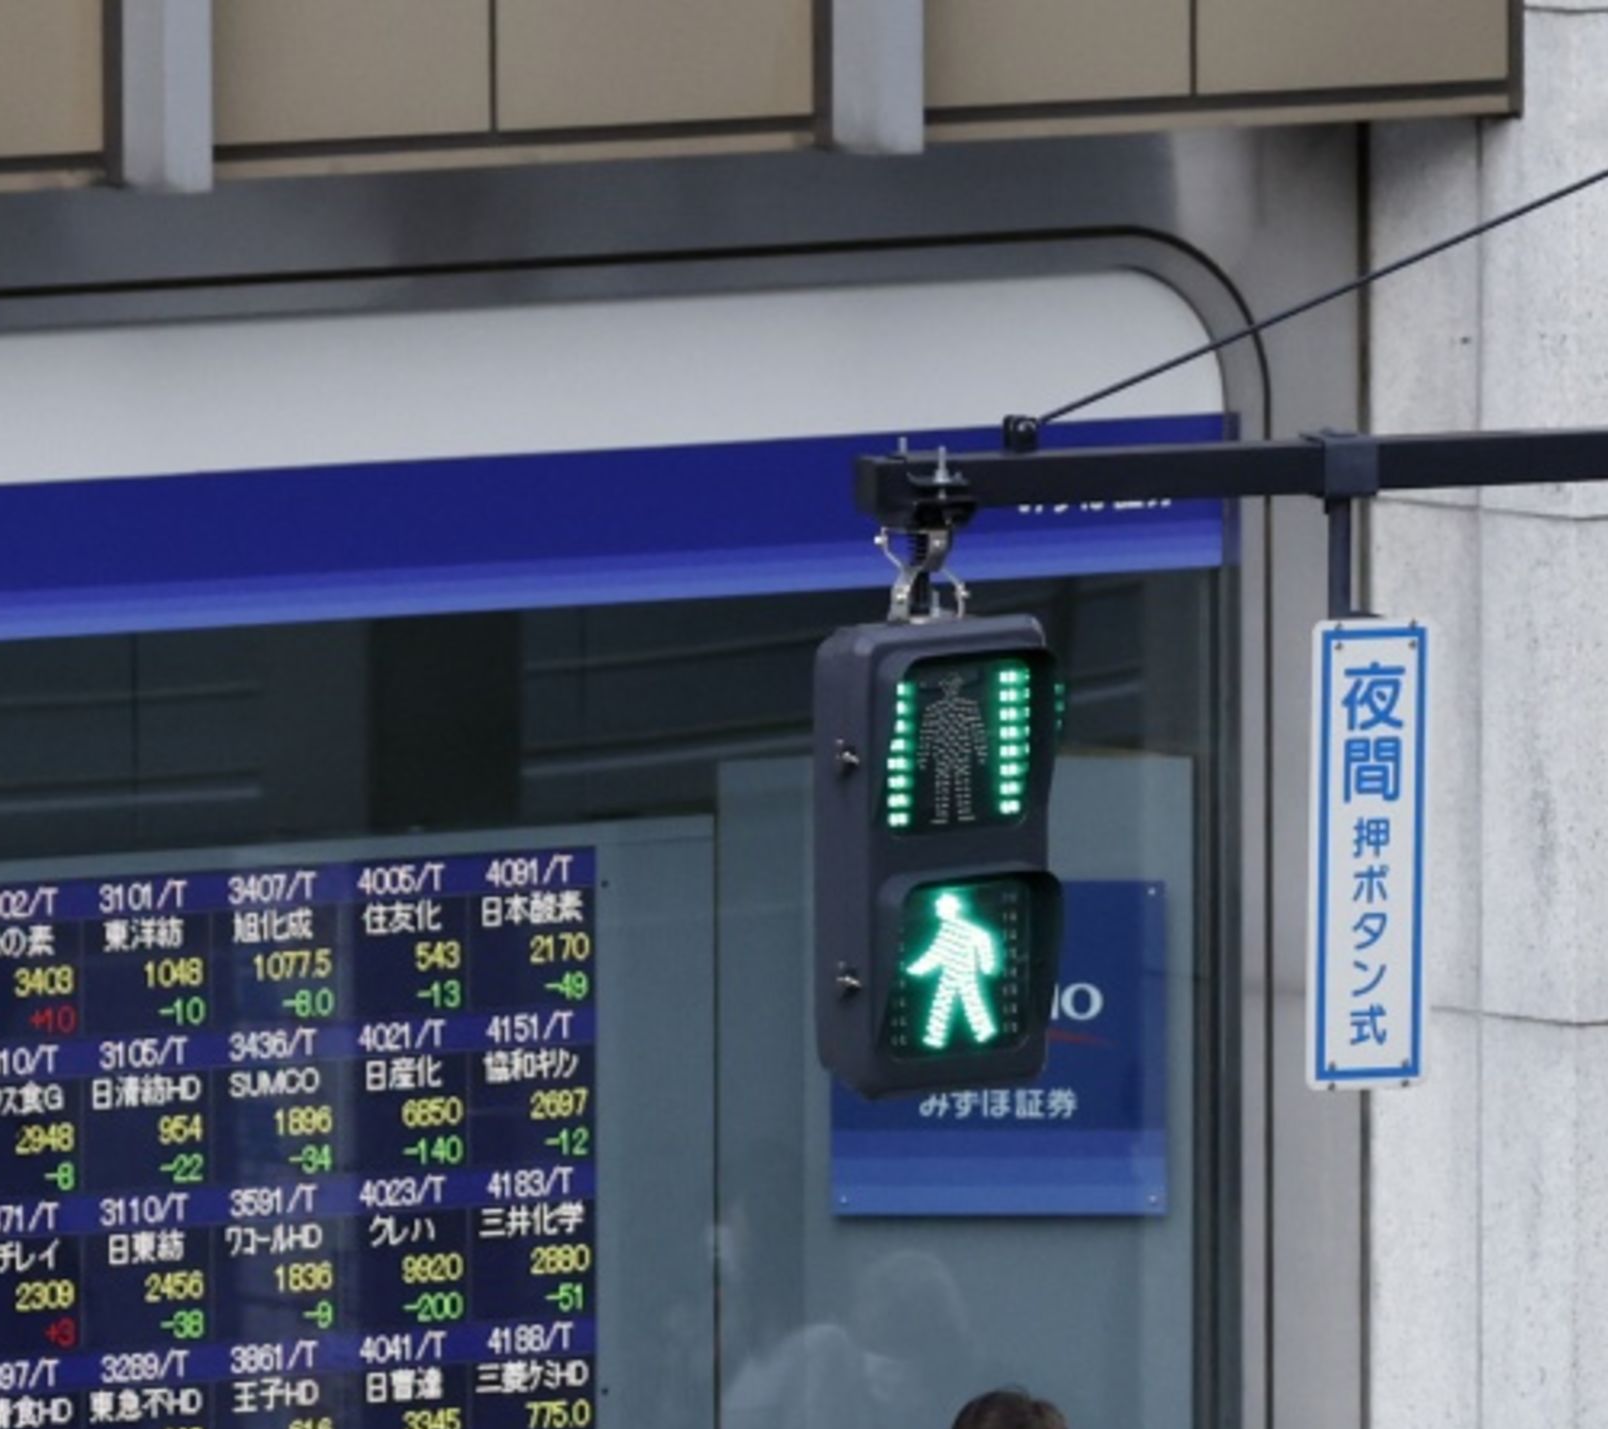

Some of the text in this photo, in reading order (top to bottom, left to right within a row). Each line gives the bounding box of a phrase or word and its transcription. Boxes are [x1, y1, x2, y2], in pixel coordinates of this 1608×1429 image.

[1341, 661, 1407, 1048] 夜間 押ボタン式
[99, 878, 188, 914] 3101/T
[228, 870, 317, 905] 3407/T
[233, 907, 314, 944] 旭化成
[362, 899, 442, 935] 住友化
[481, 889, 583, 928] 日本酸素
[103, 915, 184, 952] 東洋紡
[229, 1026, 318, 1062] 3436/T
[357, 1018, 446, 1052] 4021/T
[486, 1010, 574, 1043] 4151/T
[99, 1035, 188, 1071] 3105/T
[229, 1066, 321, 1098] SUMCO
[365, 1054, 443, 1092] 日産化
[918, 1088, 1078, 1120] みずほ証券
[358, 1174, 446, 1208] 4023/T
[487, 1165, 574, 1199] 4183/T
[99, 1191, 189, 1227] 3110/T
[479, 1201, 585, 1238] 三井化学
[369, 1214, 436, 1248] クレハ
[359, 1330, 447, 1364] 4041/T
[487, 1320, 574, 1355] 4188/T
